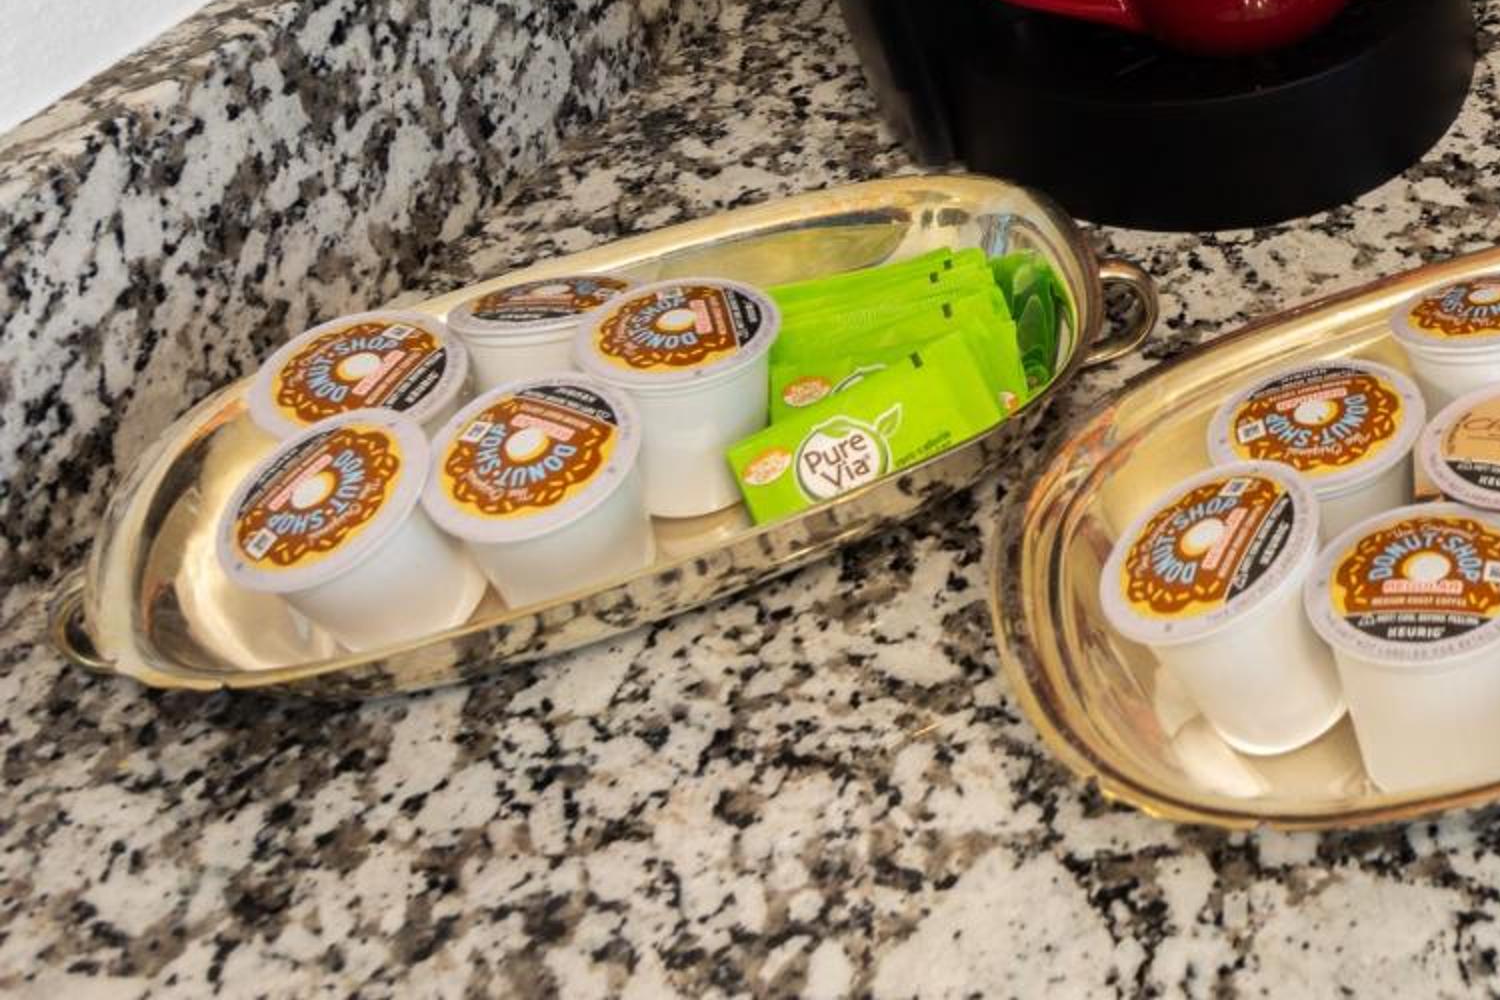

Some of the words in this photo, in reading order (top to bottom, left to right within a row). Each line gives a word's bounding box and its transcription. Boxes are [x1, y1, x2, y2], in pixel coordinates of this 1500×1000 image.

[307, 354, 349, 402] DONUT
[335, 336, 398, 355] SHOP
[1265, 412, 1313, 446] SHOP
[1321, 393, 1369, 445] DONUT
[479, 424, 506, 474] SHOP
[494, 443, 577, 487] DONUT
[804, 433, 867, 474] Pure
[329, 450, 366, 515] DONUT
[820, 458, 870, 490] Via
[1173, 495, 1239, 529] SHOP
[1152, 535, 1198, 584] DONUT
[1368, 532, 1435, 582] DONUT
[1442, 536, 1482, 583] SHOP
[1388, 626, 1443, 639] KEURIG
